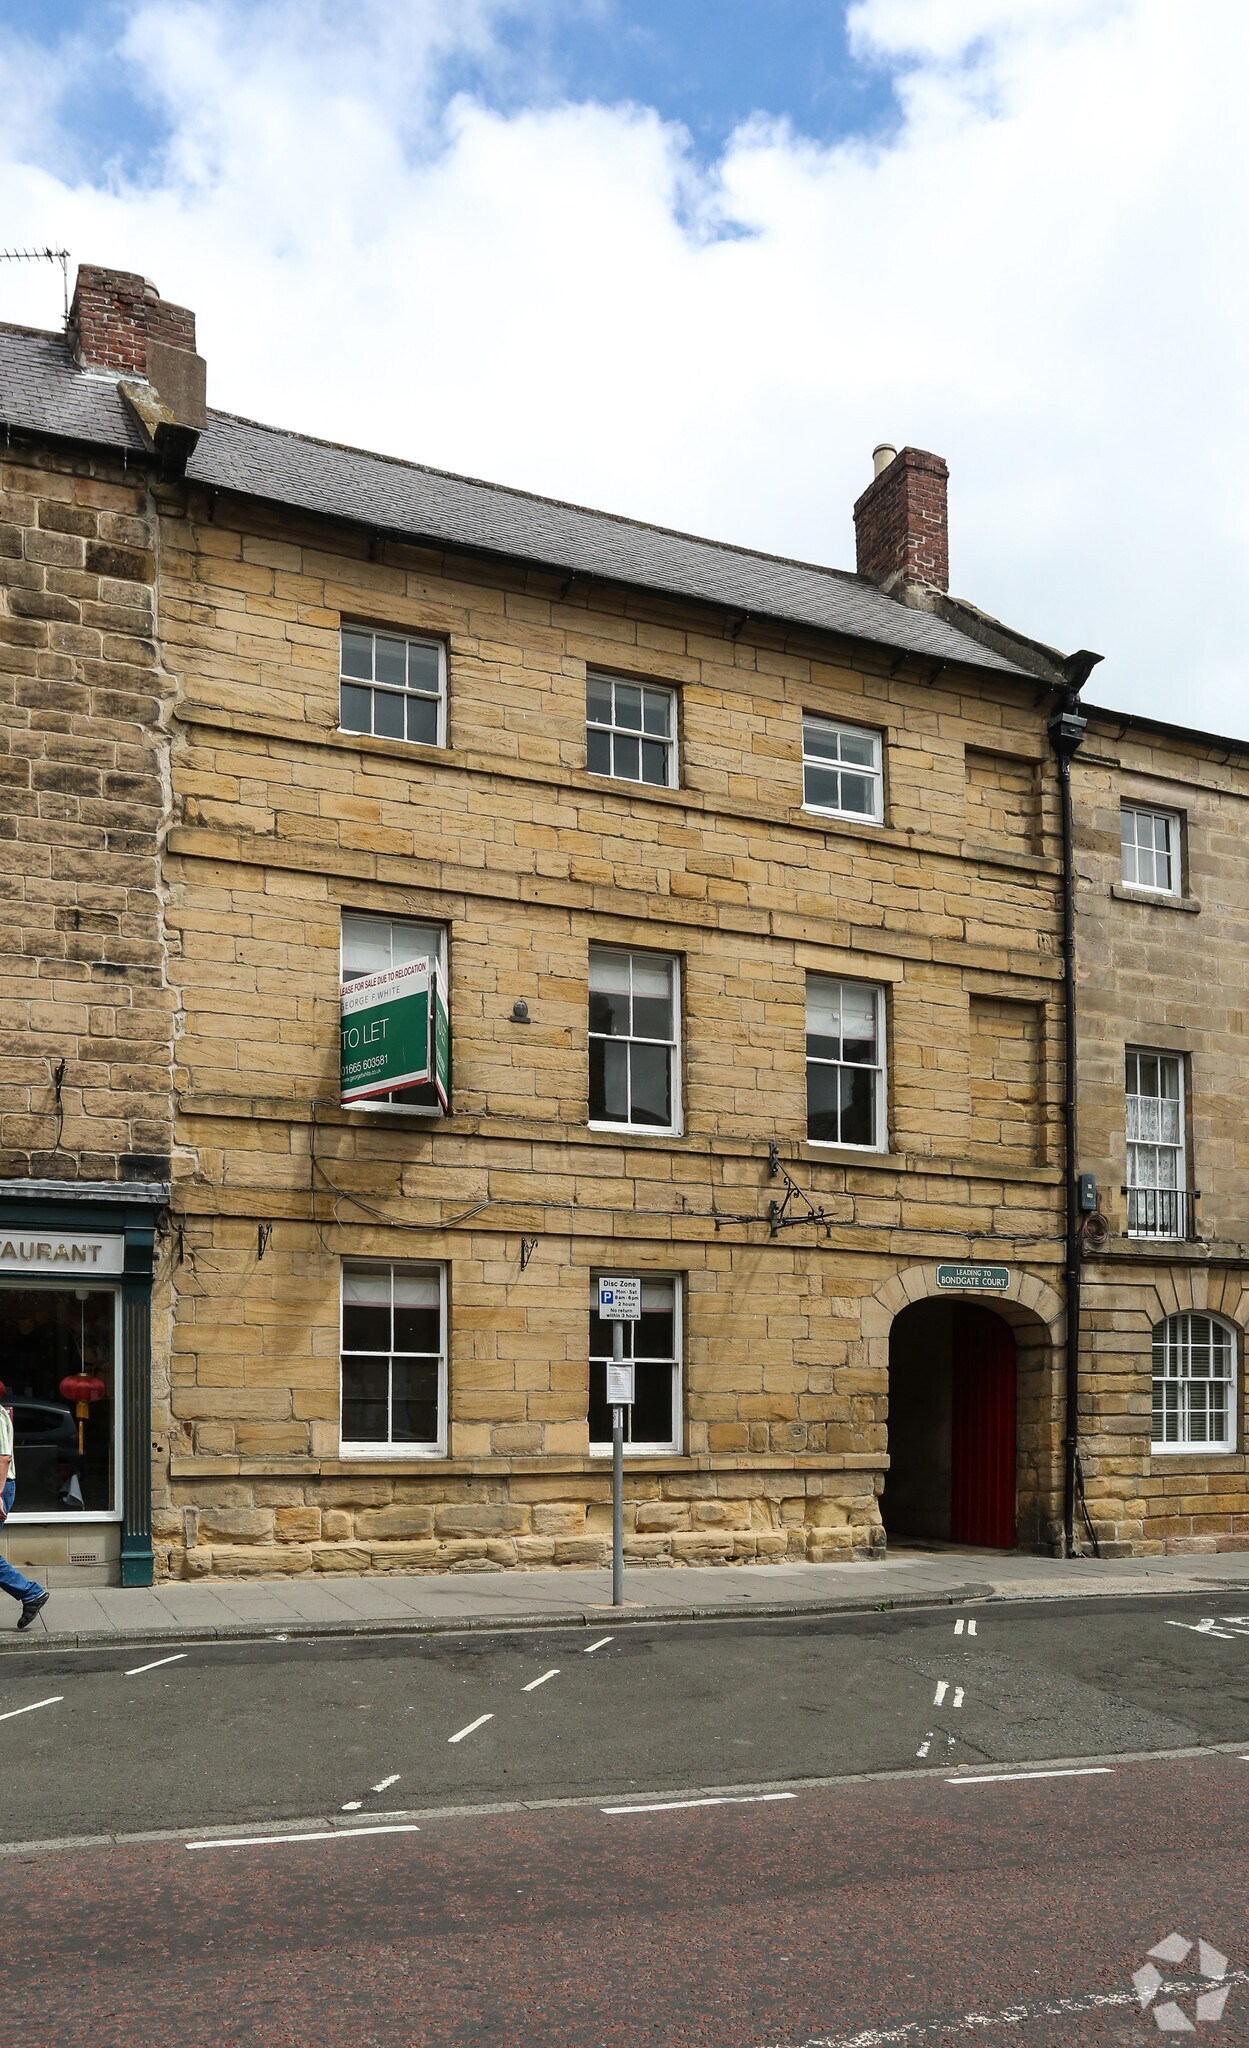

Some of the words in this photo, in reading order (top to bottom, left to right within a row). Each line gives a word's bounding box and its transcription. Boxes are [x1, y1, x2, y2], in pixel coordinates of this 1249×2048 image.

[340, 984, 354, 997] LEASE
[355, 981, 365, 992] FOR
[365, 977, 377, 989] SALE
[377, 974, 387, 985] DUE
[388, 972, 395, 981] TO
[395, 962, 427, 979] RELOCATION
[341, 995, 369, 1011] GEORGE
[341, 1027, 360, 1050] TO
[363, 1018, 390, 1044] LET
[363, 1054, 388, 1070] 603581
[0, 1241, 103, 1262] AURANT
[941, 1276, 979, 1285] BONDGATE
[982, 1278, 1006, 1286] COURT
